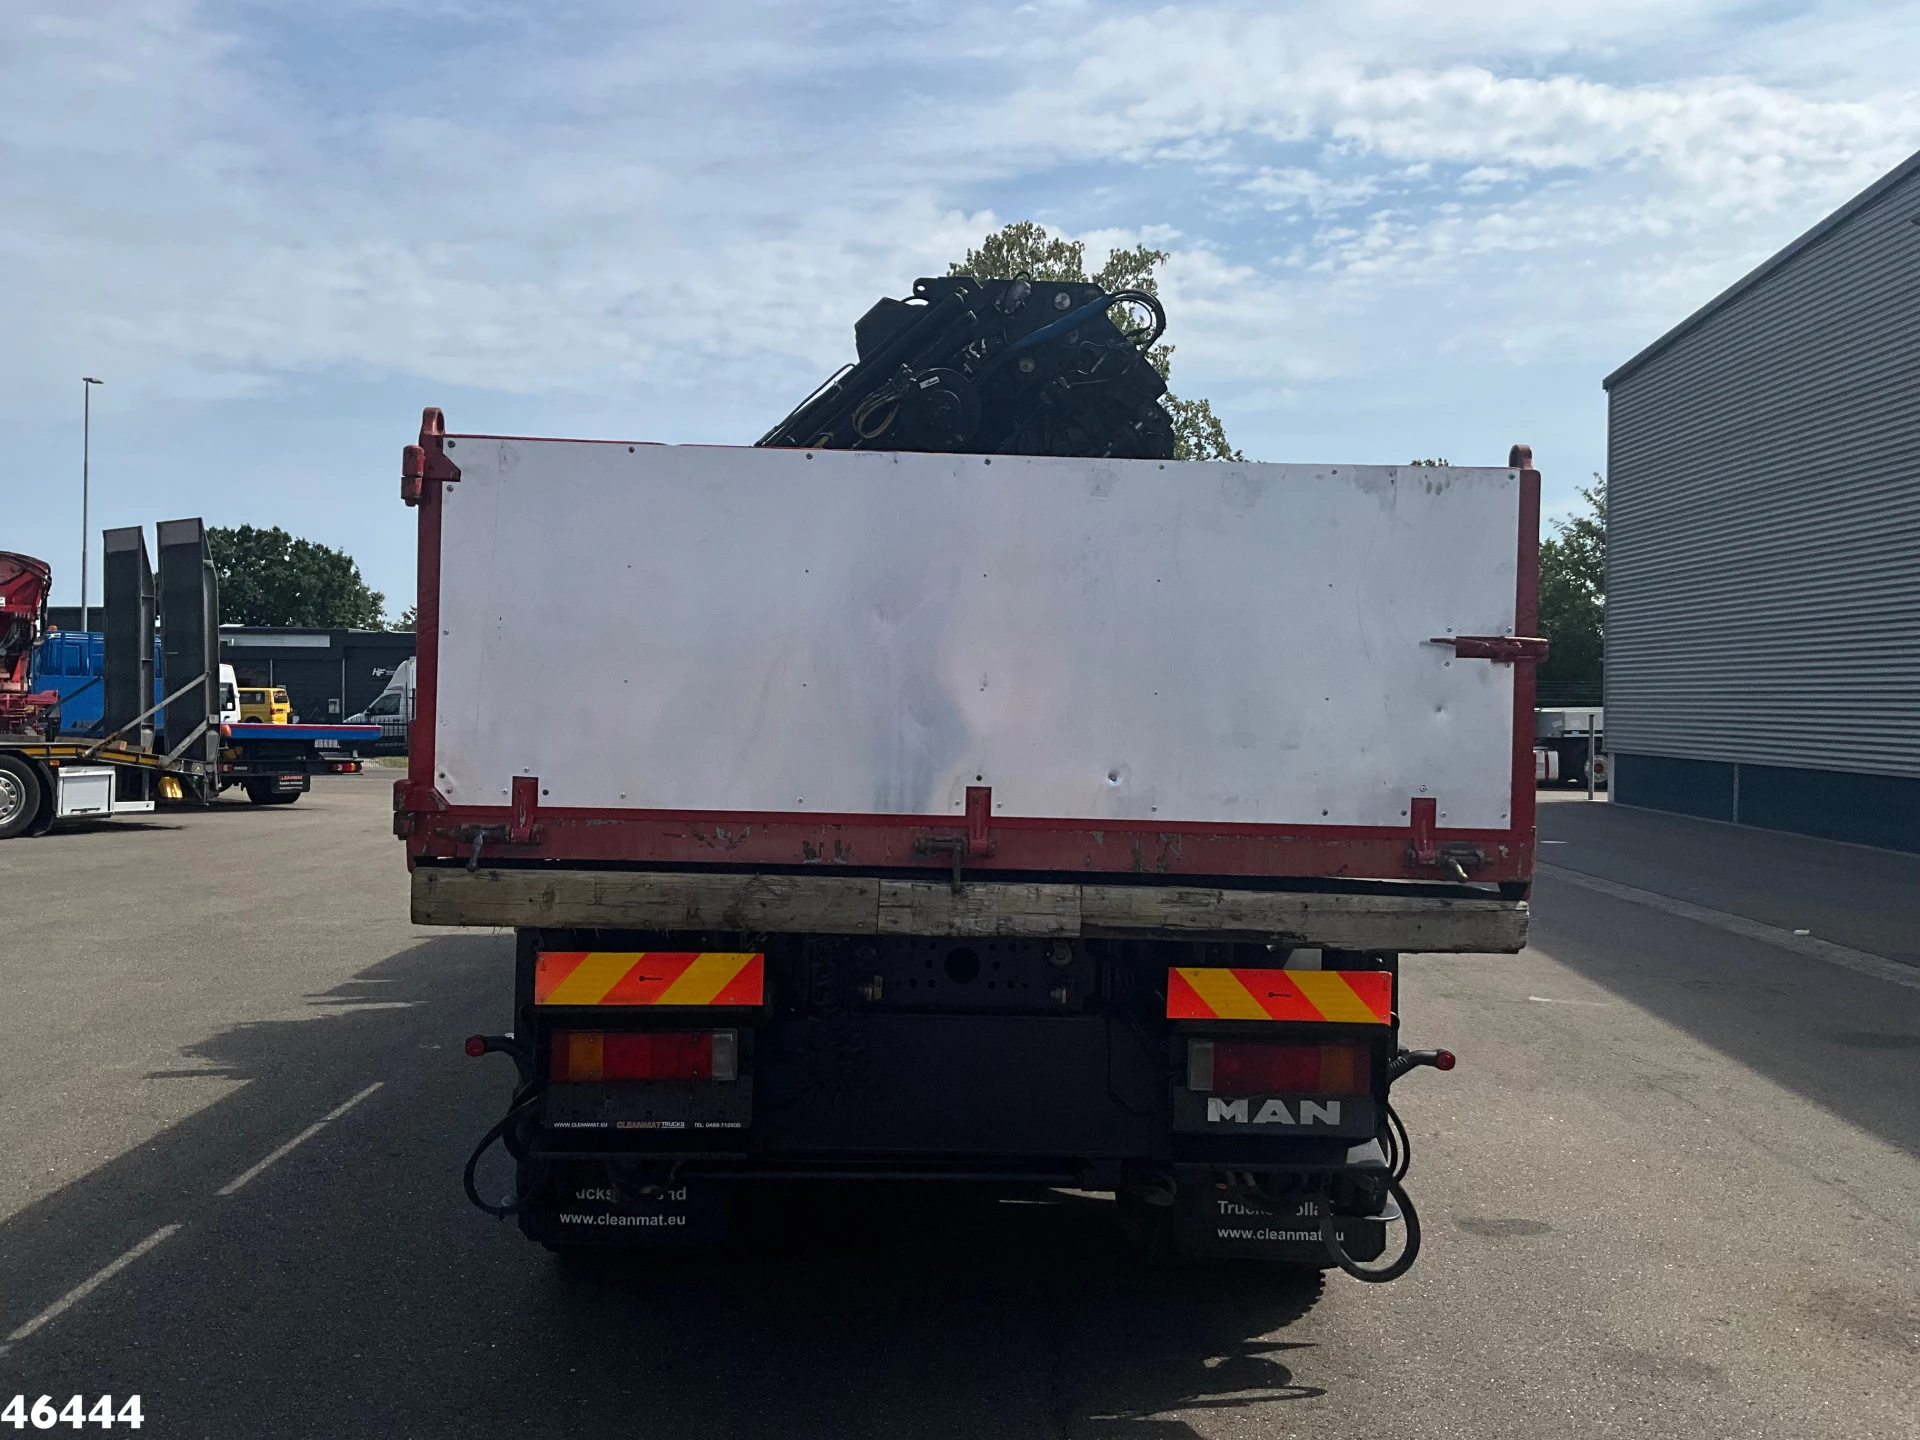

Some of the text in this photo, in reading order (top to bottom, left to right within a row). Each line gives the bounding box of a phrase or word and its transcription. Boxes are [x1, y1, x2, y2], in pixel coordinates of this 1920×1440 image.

[1207, 1098, 1341, 1126] MAN
[559, 1212, 686, 1226] www.cleanmat.eu
[1216, 1227, 1345, 1242] www.cleanmatu
